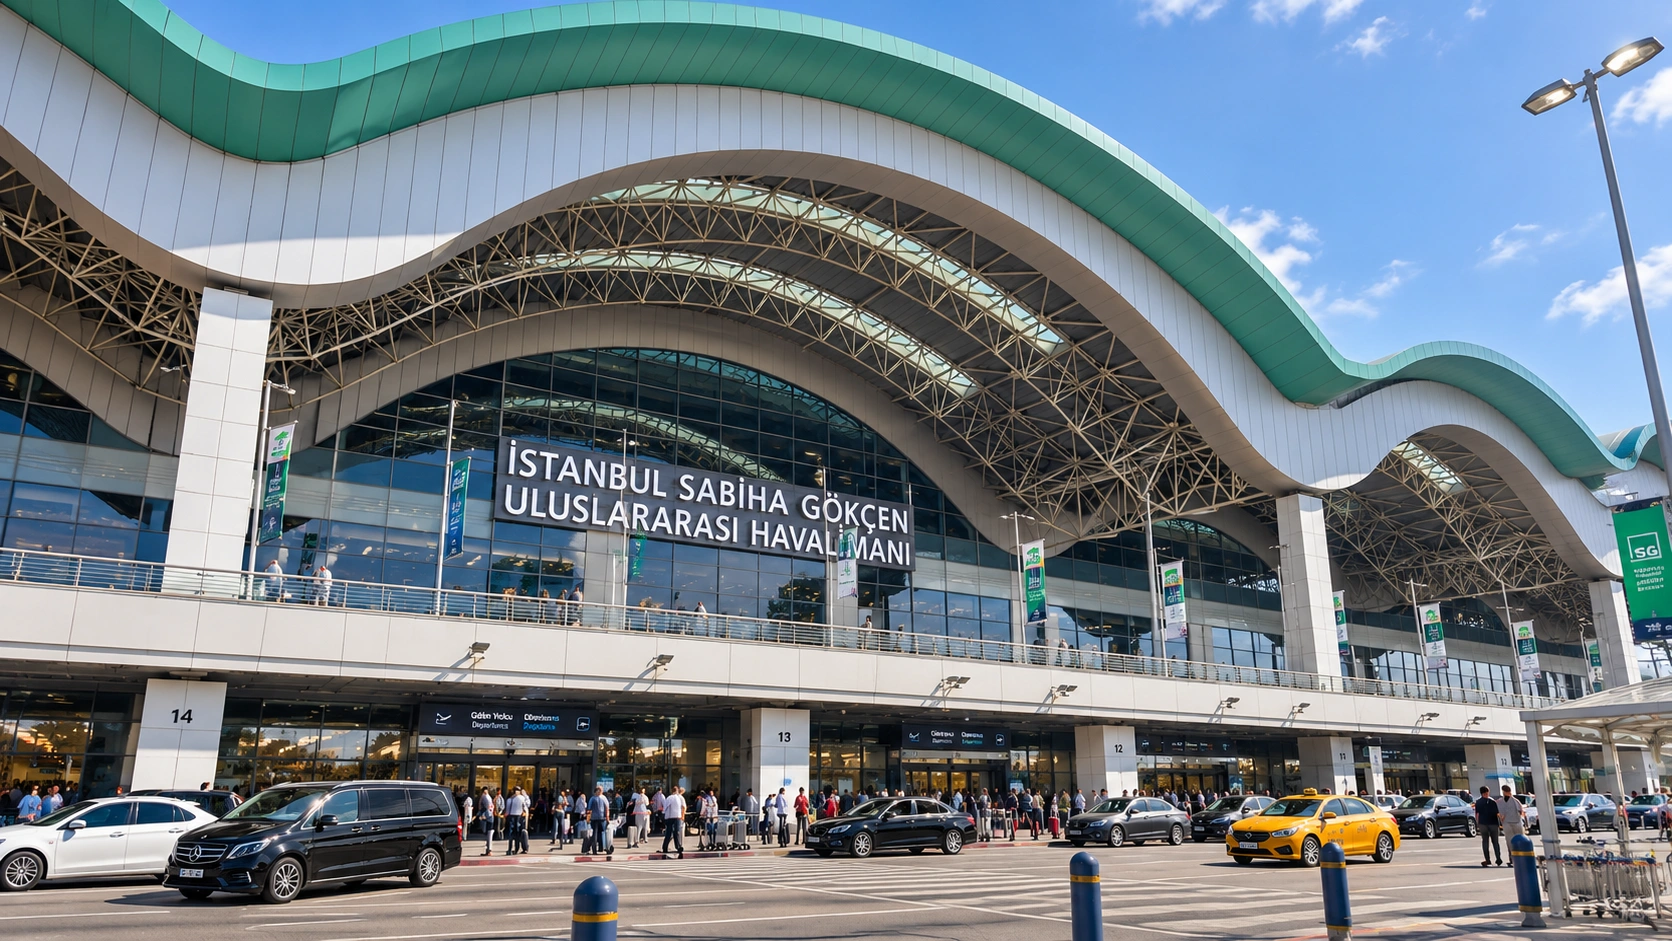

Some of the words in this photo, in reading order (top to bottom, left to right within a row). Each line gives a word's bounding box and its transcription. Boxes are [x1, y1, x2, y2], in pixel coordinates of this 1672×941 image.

[508, 439, 667, 498] İSTANBUL
[679, 474, 789, 515] SABİHA
[801, 491, 908, 534] GÖKÇEN
[504, 484, 738, 543] ULUSLARARASI
[171, 709, 193, 723] 14
[778, 732, 791, 742] 13
[1114, 744, 1123, 753] 12
